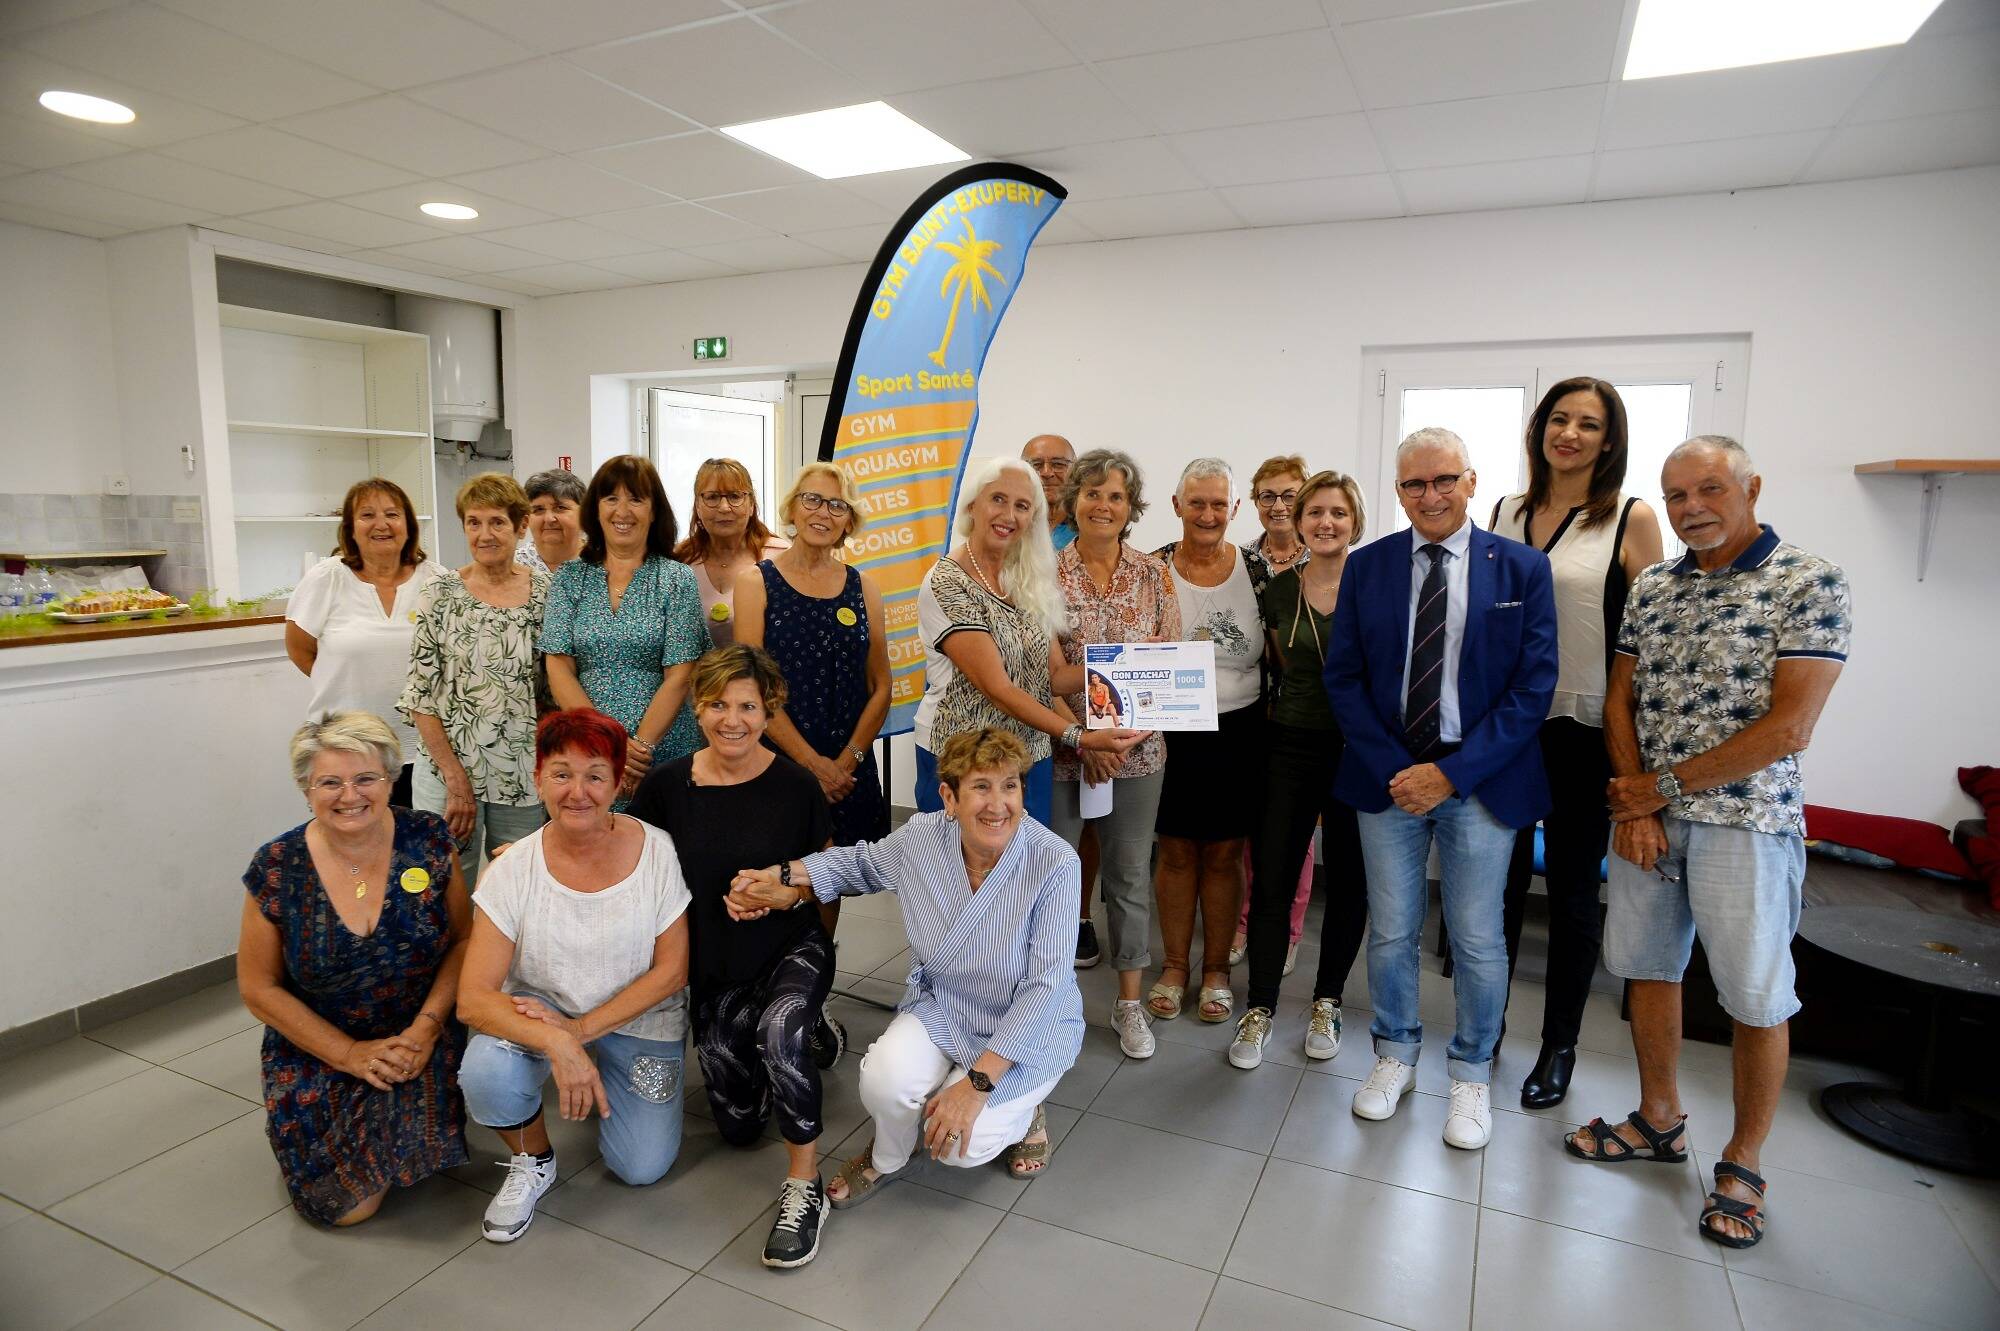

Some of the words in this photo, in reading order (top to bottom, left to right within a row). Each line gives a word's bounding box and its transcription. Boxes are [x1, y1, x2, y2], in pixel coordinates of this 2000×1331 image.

[872, 267, 910, 320] GYM
[901, 181, 1046, 266] SAINT-EXUPERY
[856, 372, 912, 399] Sport
[918, 368, 975, 390] Santé
[850, 413, 897, 437] GYM
[844, 445, 940, 480] AQUAGYM
[861, 489, 910, 513] ATES
[851, 527, 914, 556] GONG
[887, 638, 923, 662] ÔTE
[1112, 671, 1131, 680] BON
[1132, 670, 1171, 680] D'ACHAT
[1177, 674, 1196, 684] 1000
[1198, 674, 1204, 683] €
